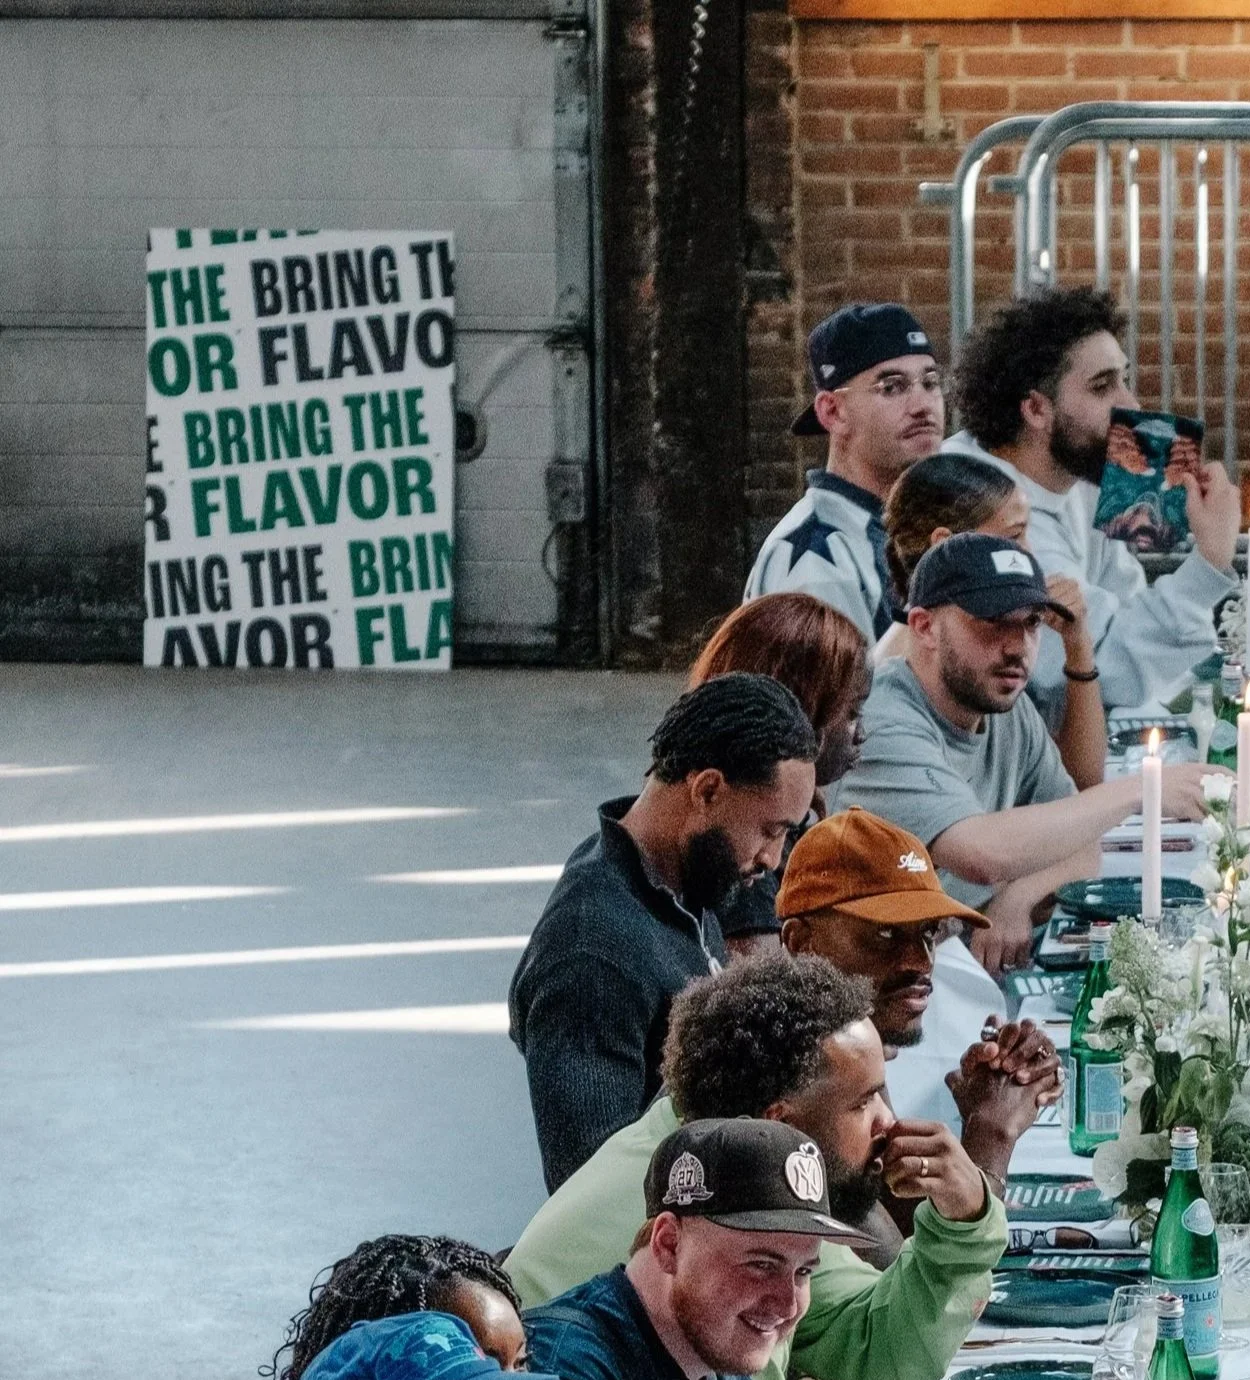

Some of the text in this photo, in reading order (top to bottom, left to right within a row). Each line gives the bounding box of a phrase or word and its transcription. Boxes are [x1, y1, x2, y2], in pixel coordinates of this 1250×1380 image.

[147, 263, 230, 329] THE
[250, 244, 401, 318] BRING
[148, 308, 454, 397] OR FLAVO
[183, 397, 333, 470] BRING
[342, 385, 429, 453] THE
[191, 455, 436, 538] FLAVOR
[148, 554, 231, 618] ING
[241, 543, 327, 609] THE
[161, 612, 334, 668] AVOR
[678, 1170, 694, 1186] 27
